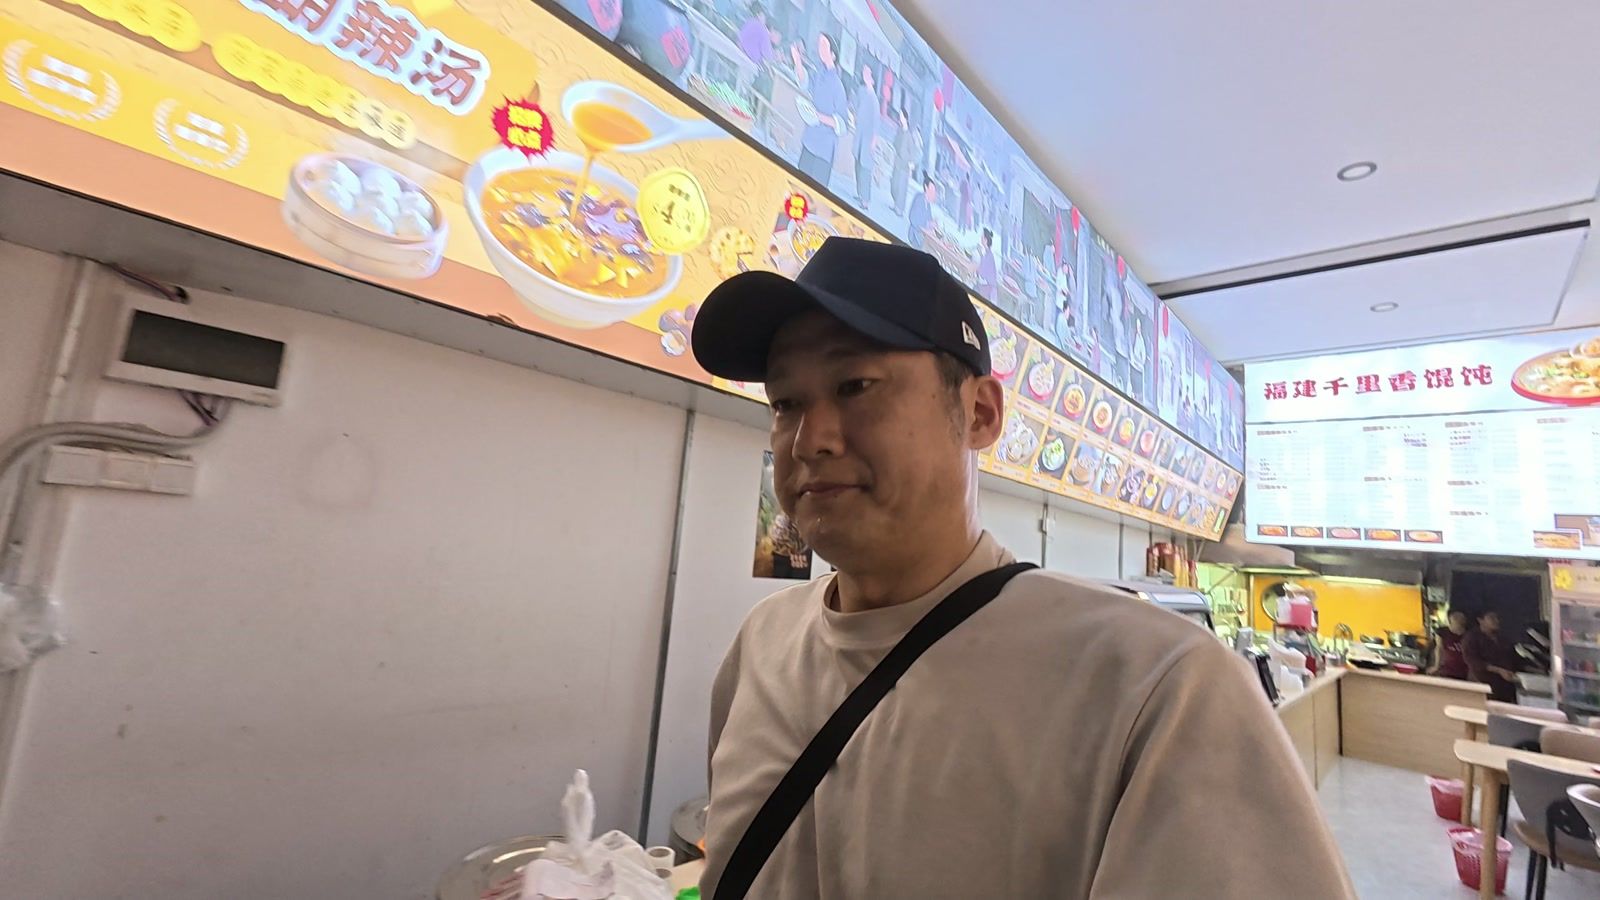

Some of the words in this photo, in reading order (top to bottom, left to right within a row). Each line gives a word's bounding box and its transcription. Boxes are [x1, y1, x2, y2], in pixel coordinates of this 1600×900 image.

[1264, 364, 1493, 400] 福建千里香馄饨
